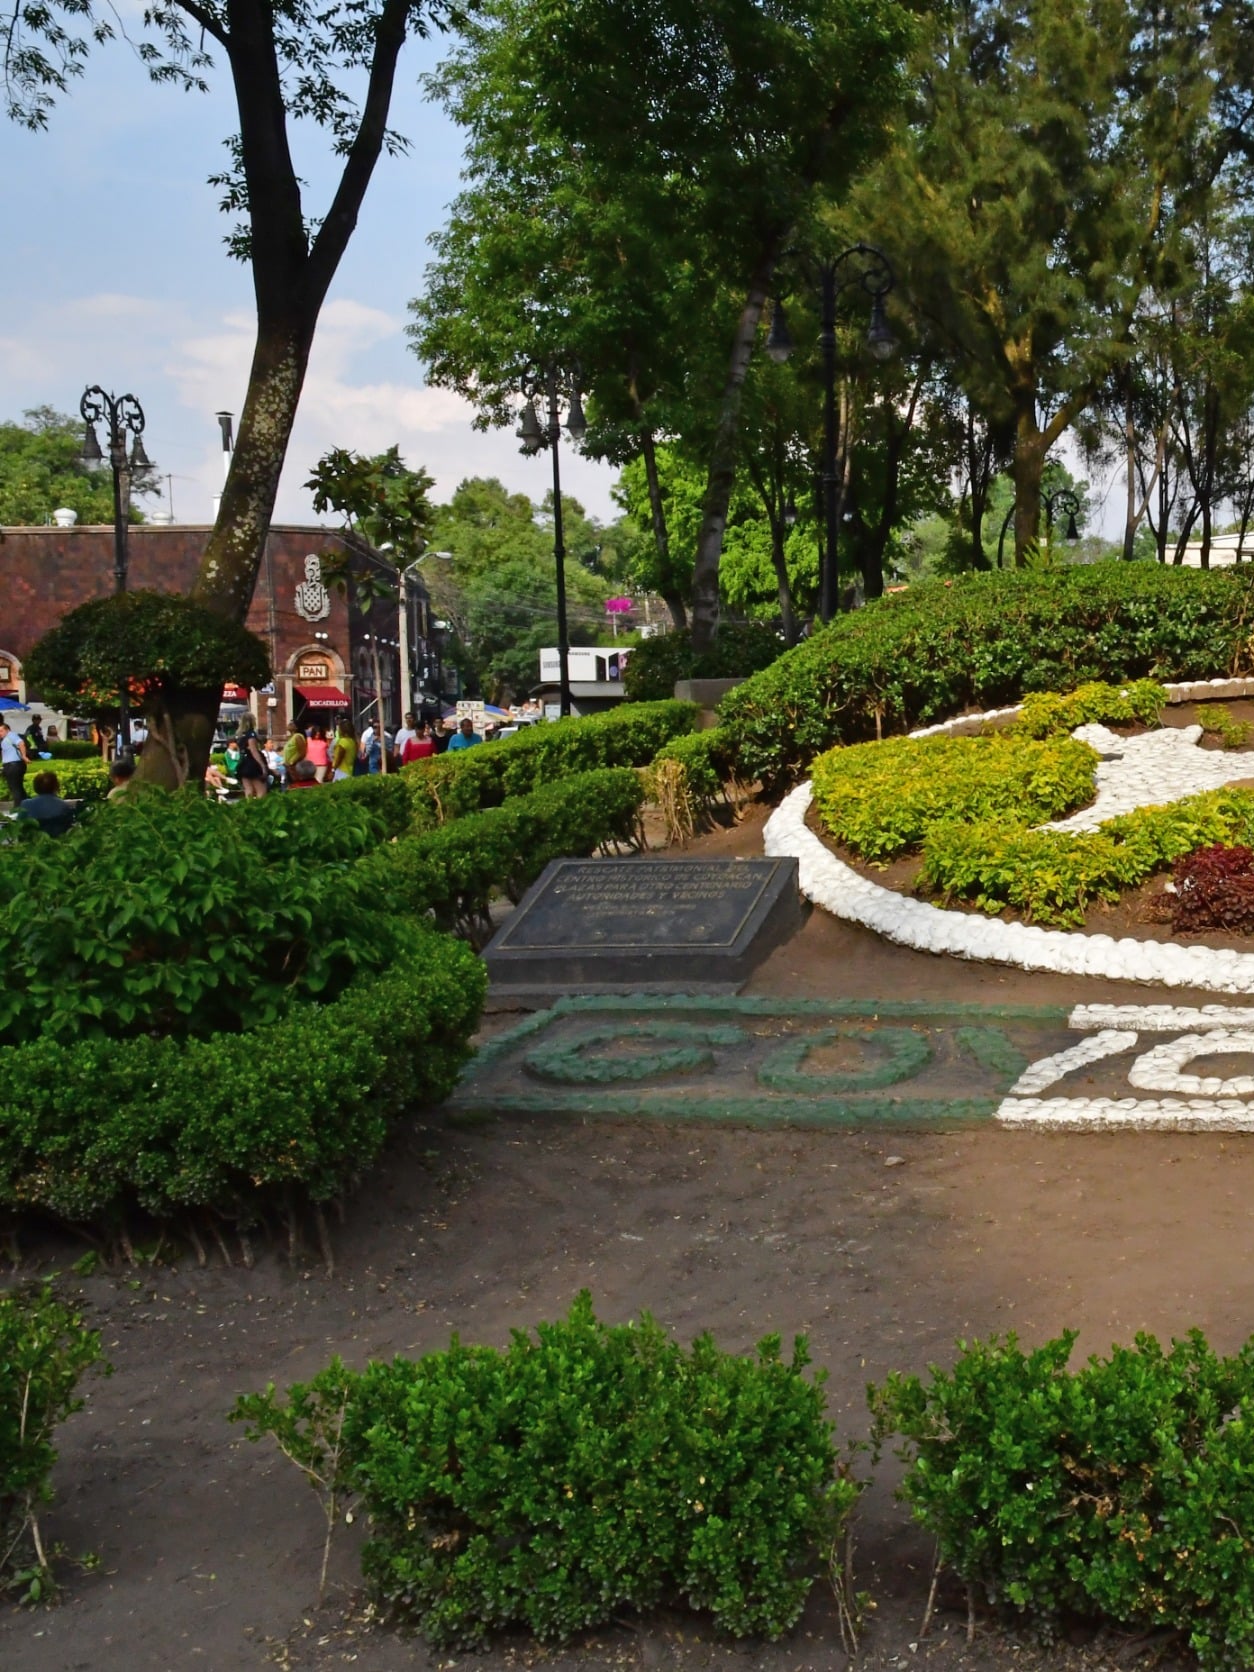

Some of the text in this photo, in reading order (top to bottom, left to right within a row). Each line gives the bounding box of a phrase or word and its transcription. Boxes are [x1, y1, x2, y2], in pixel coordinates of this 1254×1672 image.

[303, 667, 323, 676] PAN
[577, 865, 633, 873] RESCATE
[639, 864, 722, 873] PATRIMONIAL
[557, 874, 604, 882] CENTRO
[673, 891, 725, 899] VECINOS
